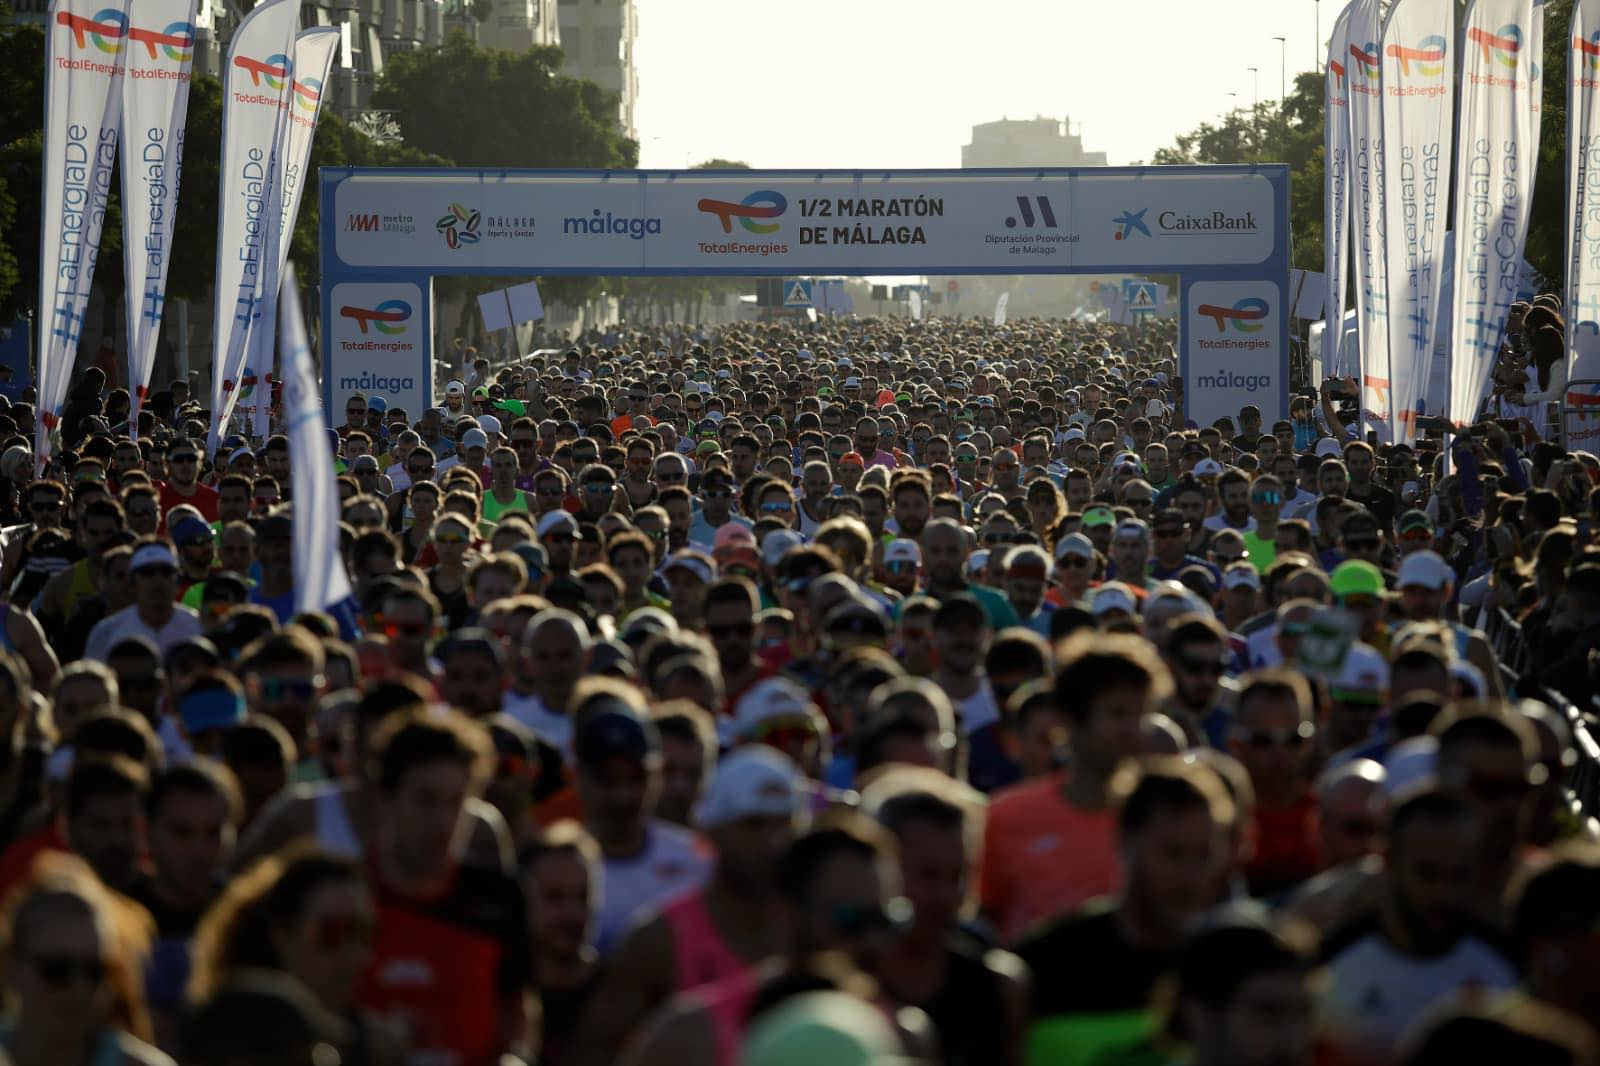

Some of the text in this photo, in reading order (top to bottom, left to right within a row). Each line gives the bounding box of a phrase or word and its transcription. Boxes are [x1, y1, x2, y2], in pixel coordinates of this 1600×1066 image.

[799, 194, 944, 217] 1/2 MARATÓN
[383, 215, 413, 223] metro
[1158, 210, 1257, 231] CaixaBank
[799, 222, 927, 245] DE MÁLAGA
[985, 233, 1080, 246] Diputación Provincial
[698, 242, 788, 257] TotalEnergies
[1009, 245, 1056, 256] de Málaga
[340, 341, 414, 353] TotalEnergies
[1197, 339, 1271, 351] TotalEnergies
